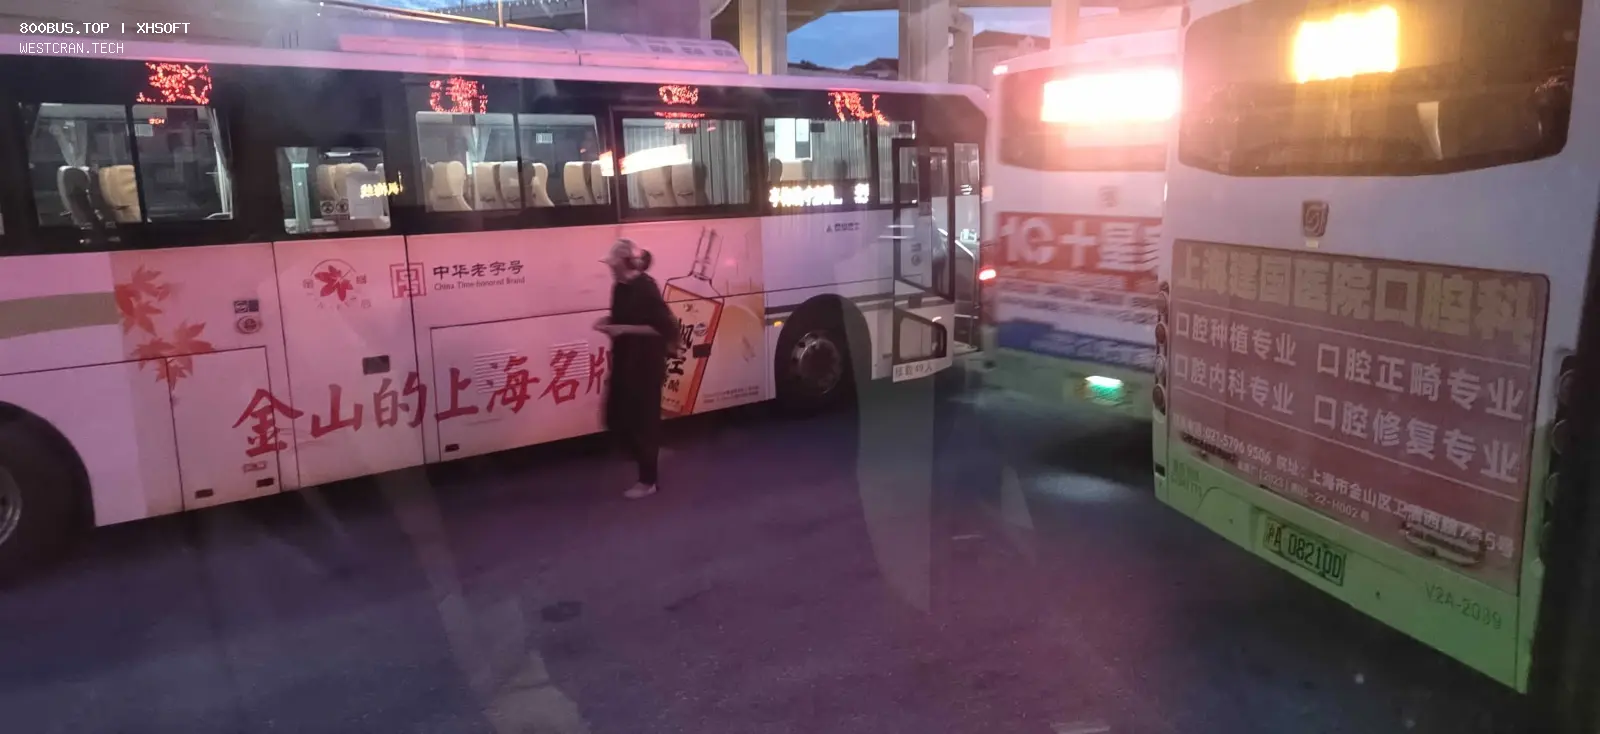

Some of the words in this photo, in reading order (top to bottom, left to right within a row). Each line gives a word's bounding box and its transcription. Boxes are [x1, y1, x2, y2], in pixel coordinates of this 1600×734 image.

[432, 259, 525, 280] 中华老字号
[1176, 246, 1533, 346] 上海建国医院口腔科
[1174, 353, 1295, 416] 口腔内科专业
[1313, 395, 1521, 485] 口腔修复专业
[1175, 311, 1297, 367] 口腔种植专业
[1316, 343, 1525, 422] 口腔正畸专业
